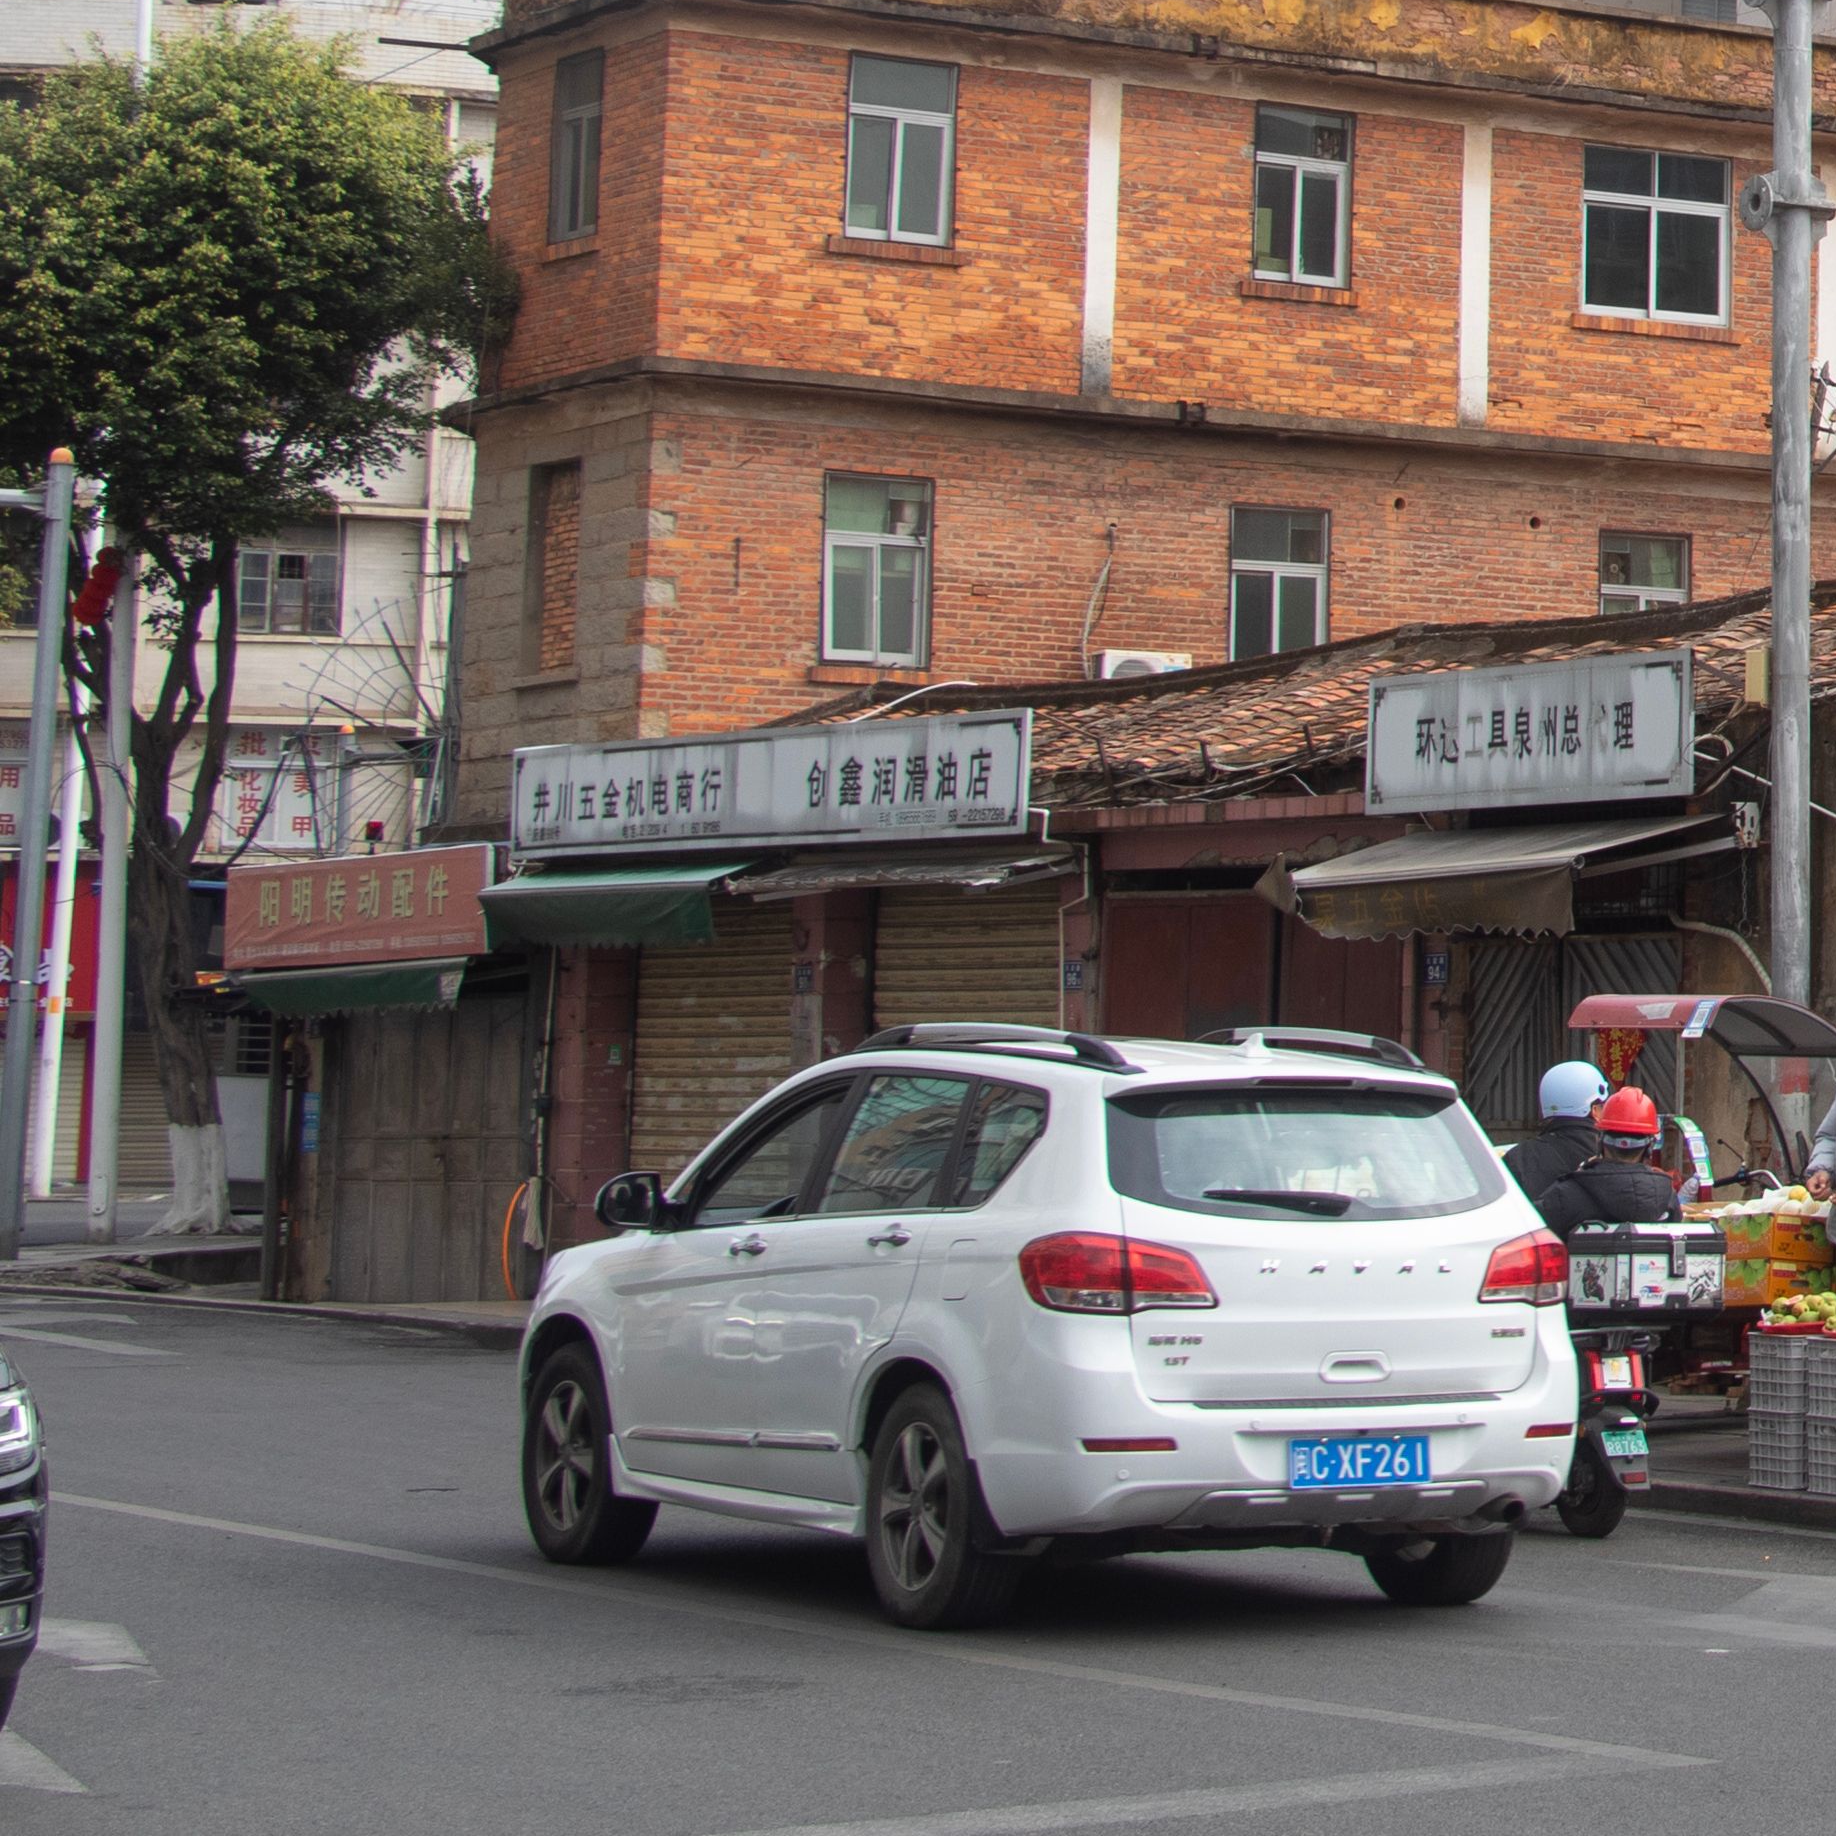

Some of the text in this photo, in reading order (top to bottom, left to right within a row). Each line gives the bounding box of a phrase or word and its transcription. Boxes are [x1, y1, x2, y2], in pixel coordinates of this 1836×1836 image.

[237, 770, 263, 837] 化妆品
[292, 772, 311, 837] 美甲
[533, 768, 721, 822] 井川五金机电商行
[808, 748, 992, 807] 创鑫润滑油店
[259, 864, 449, 928] 阳明传动配件
[1258, 1259, 1452, 1274] HAVAL
